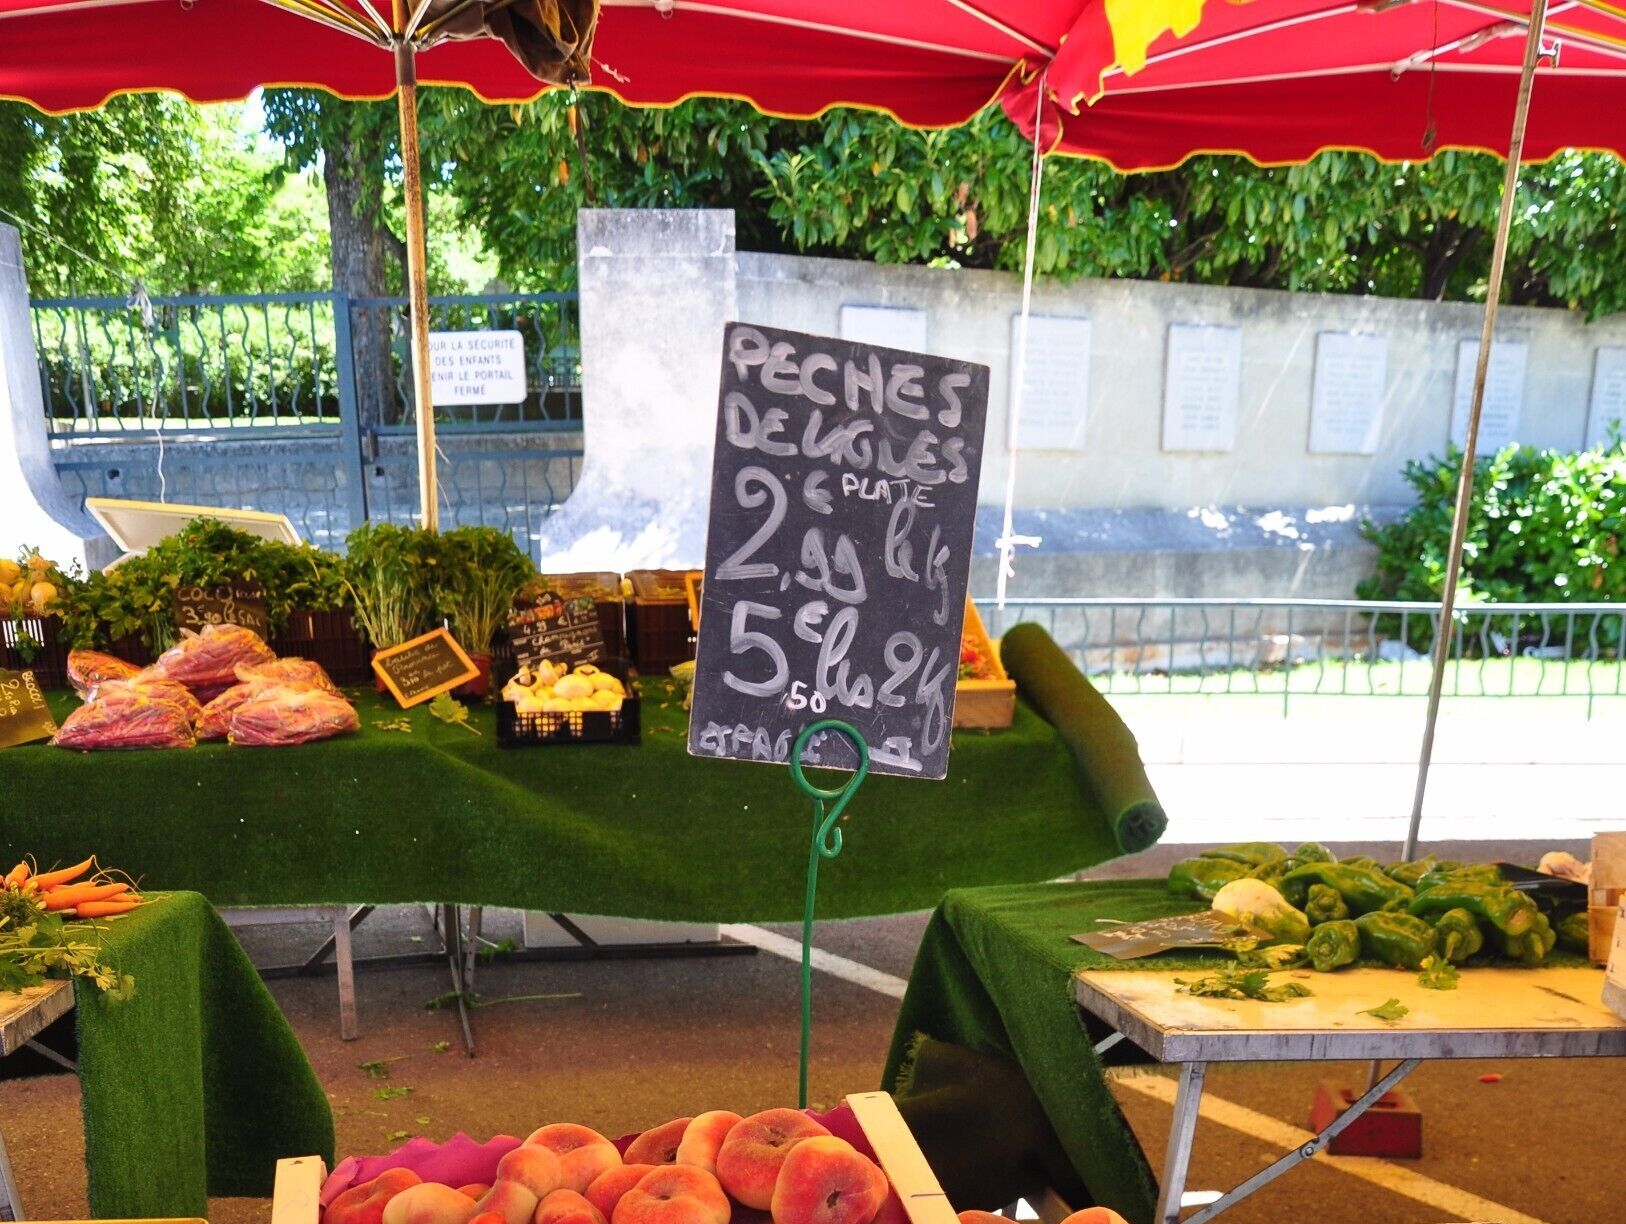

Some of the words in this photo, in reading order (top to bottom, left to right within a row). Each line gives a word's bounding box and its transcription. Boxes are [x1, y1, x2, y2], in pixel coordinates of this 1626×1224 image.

[452, 340, 463, 350] LA
[435, 357, 454, 366] DES
[460, 354, 502, 366] ENFANTS
[431, 371, 453, 382] ENIR
[459, 370, 469, 381] LE
[474, 369, 513, 381] PORTAIL
[728, 326, 971, 428] PECHES
